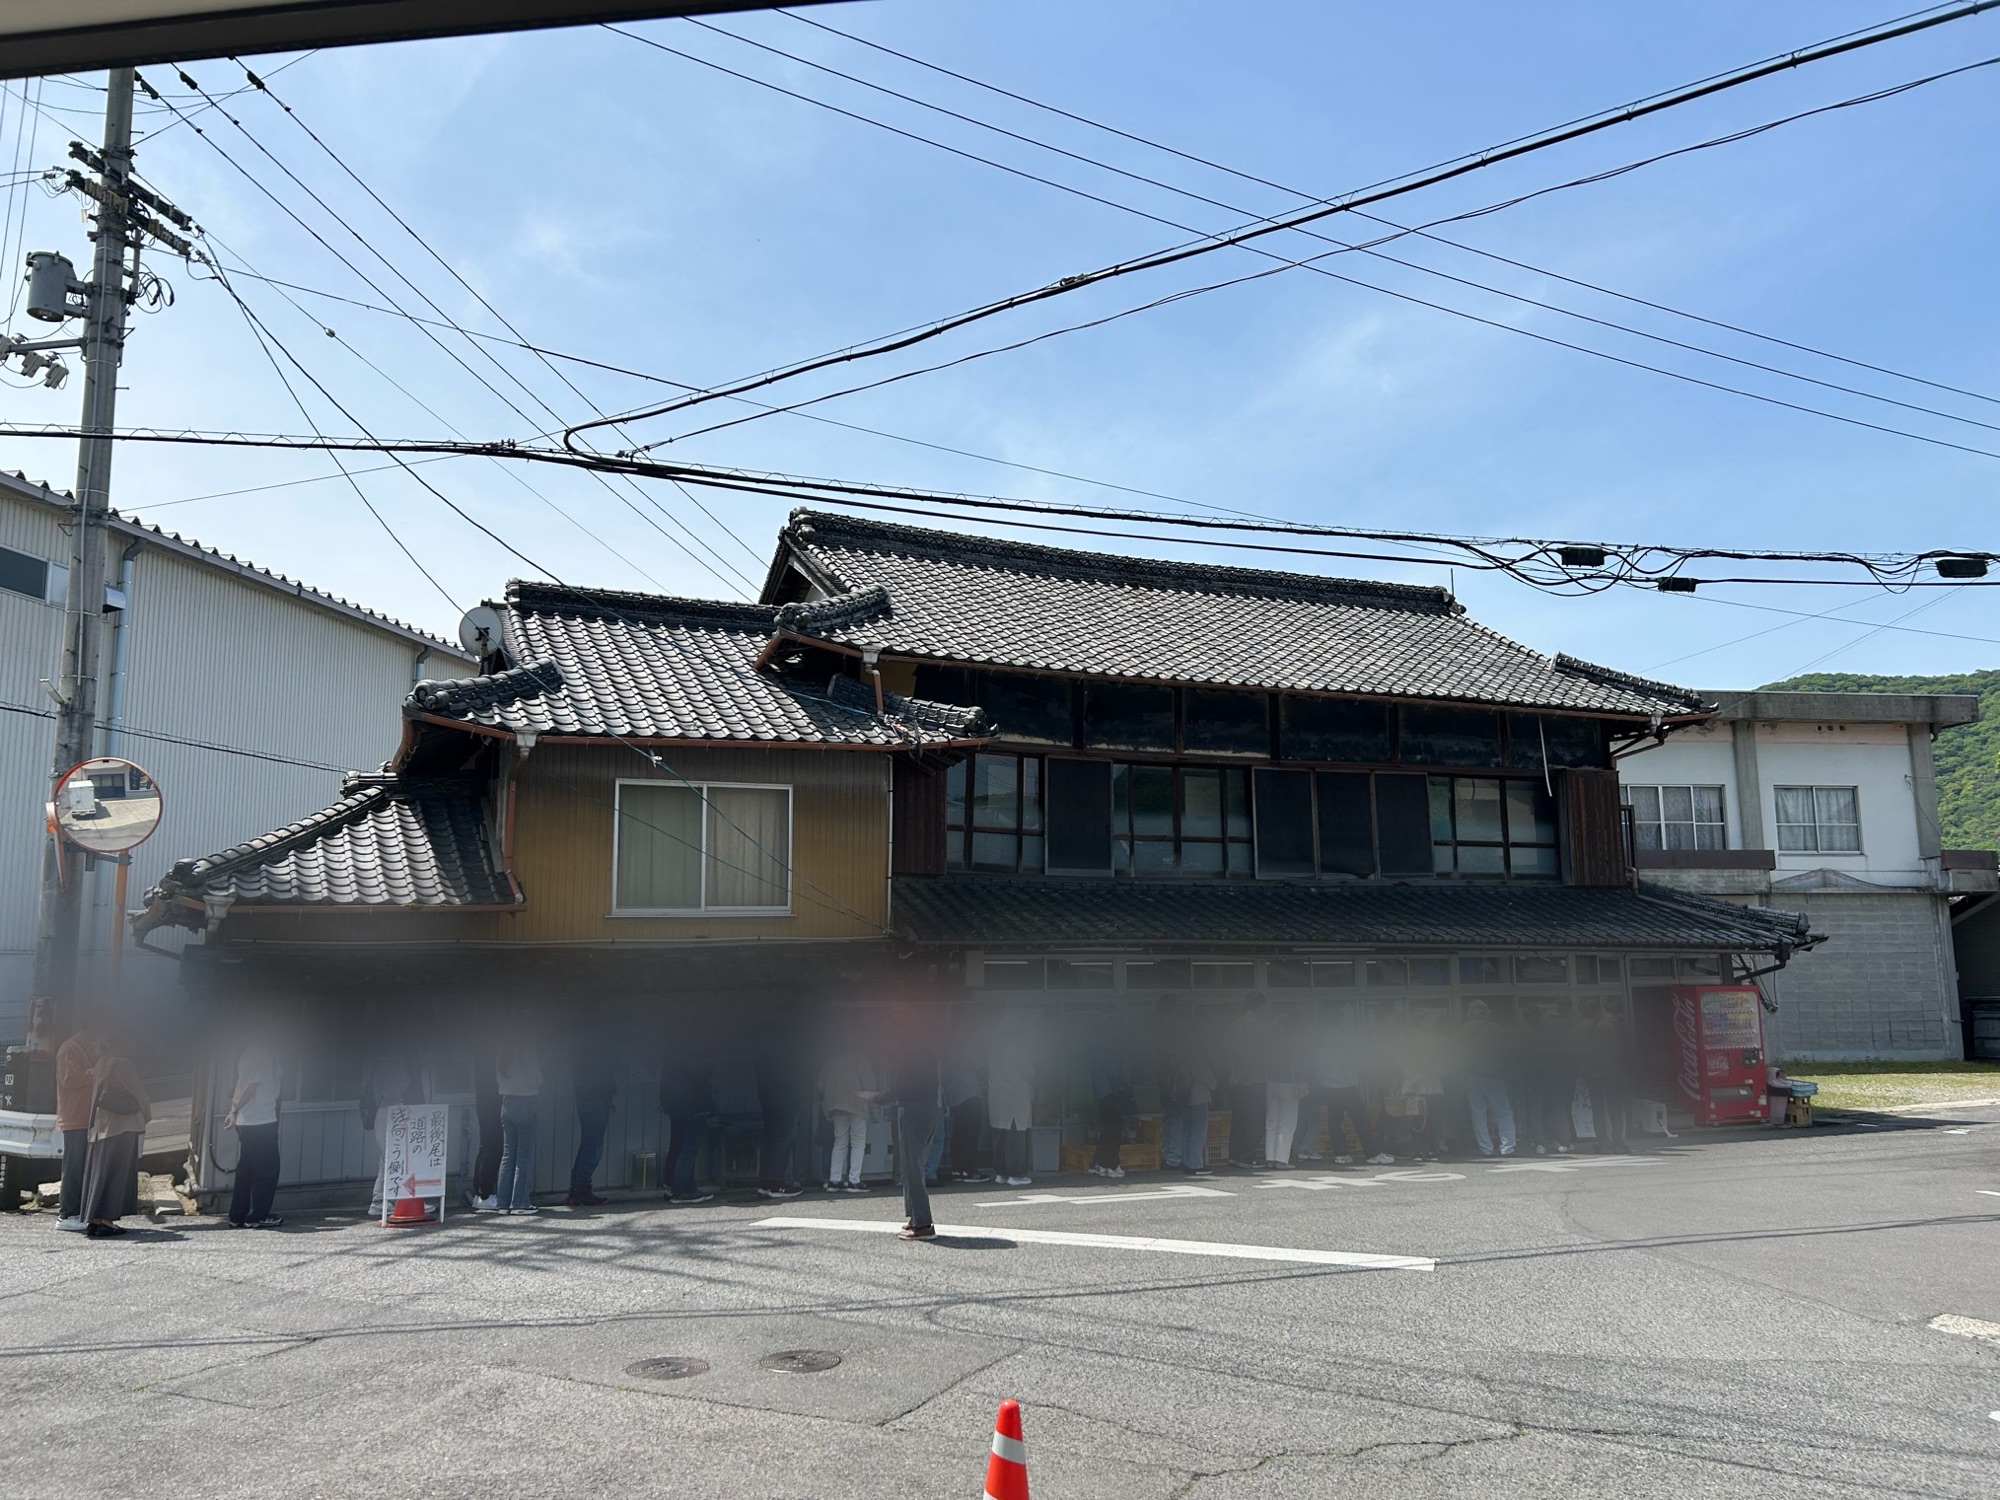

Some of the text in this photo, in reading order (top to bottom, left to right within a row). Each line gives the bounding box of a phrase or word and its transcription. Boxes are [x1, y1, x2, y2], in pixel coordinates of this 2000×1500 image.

[409, 1117, 426, 1154] 道路の
[428, 1110, 445, 1168] 最後尾は
